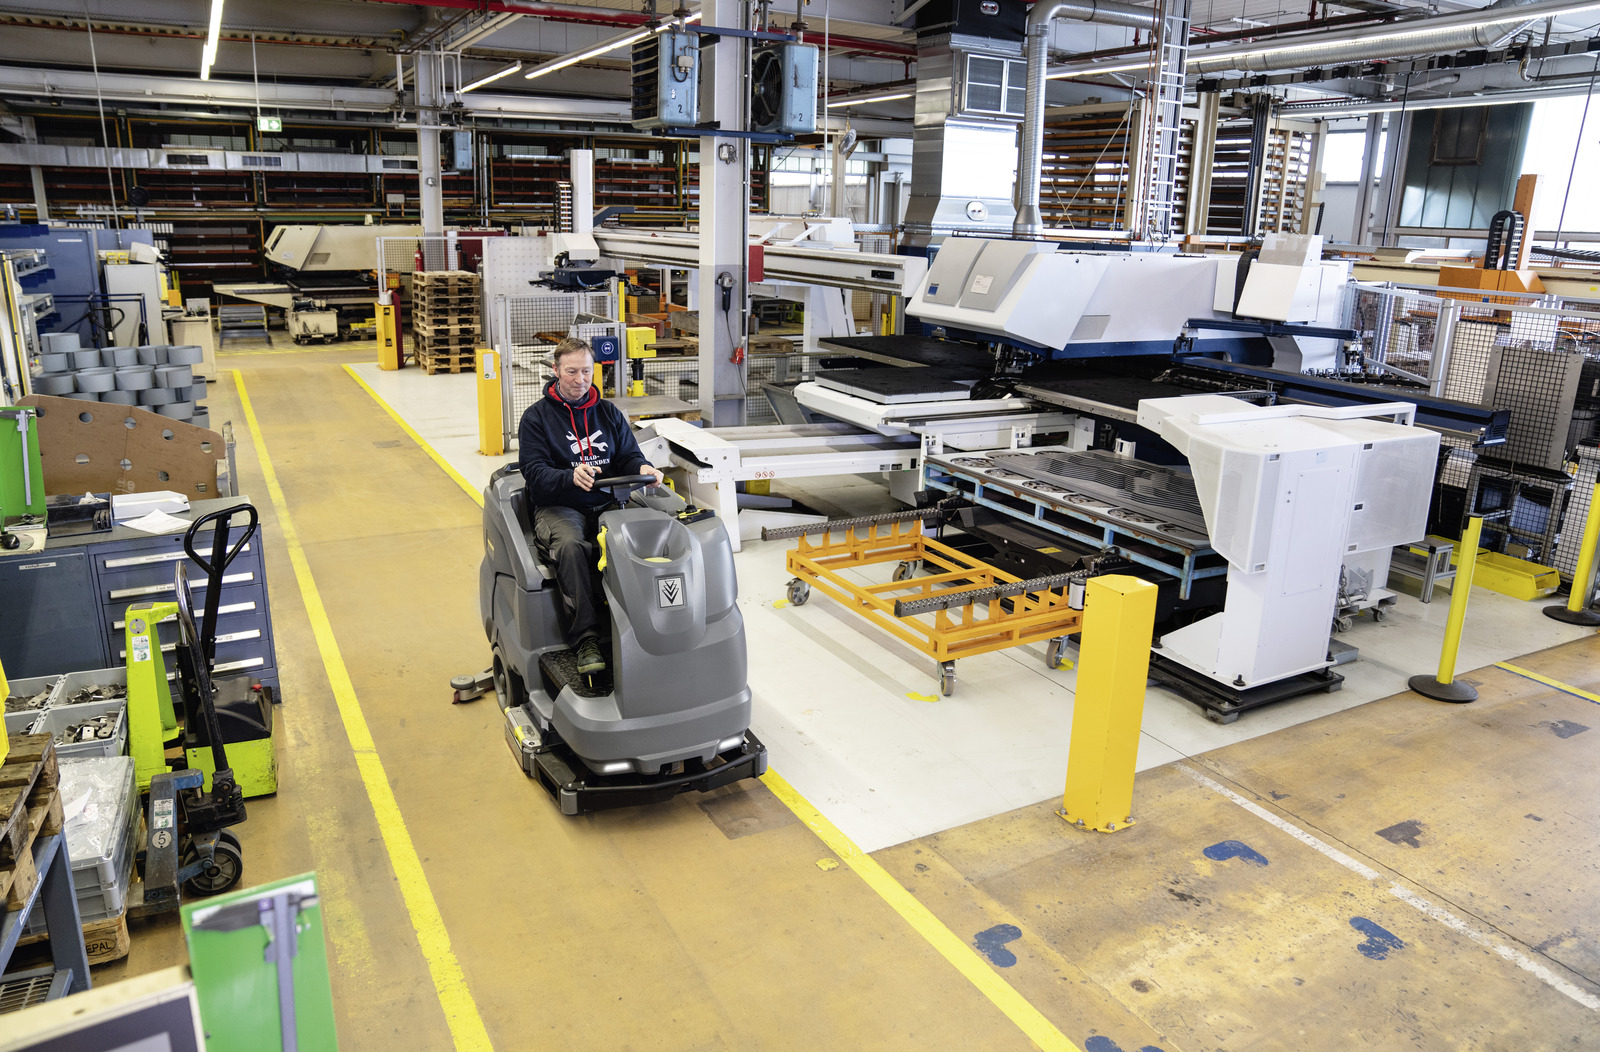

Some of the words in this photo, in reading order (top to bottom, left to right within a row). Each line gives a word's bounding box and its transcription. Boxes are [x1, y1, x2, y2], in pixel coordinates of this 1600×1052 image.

[678, 104, 683, 113] 2
[798, 112, 803, 121] 2
[158, 833, 166, 845] 5
[86, 941, 111, 953] EPAL
